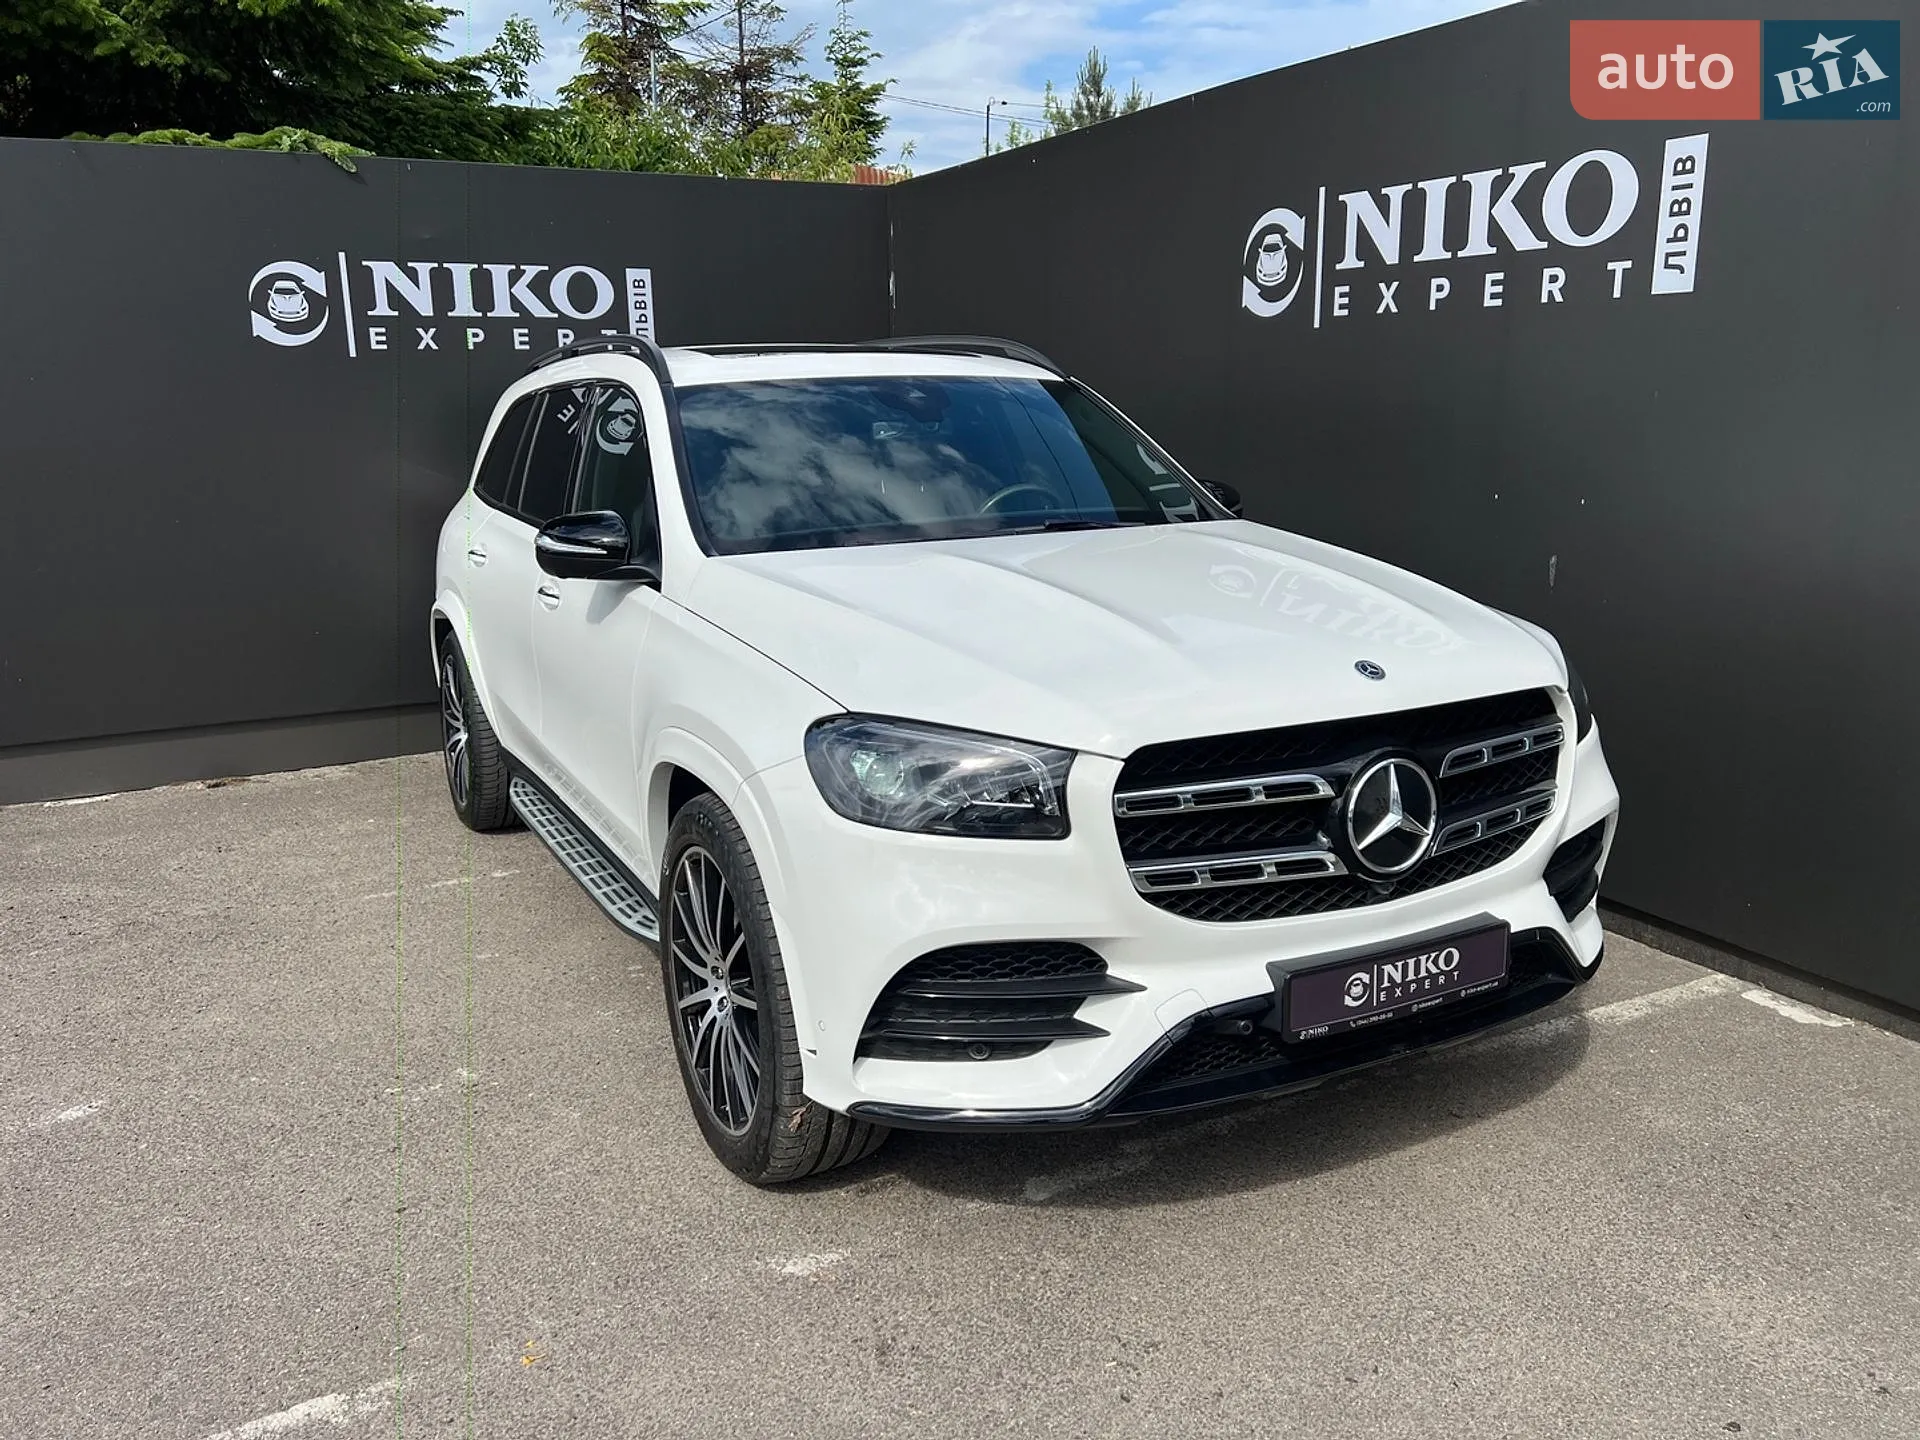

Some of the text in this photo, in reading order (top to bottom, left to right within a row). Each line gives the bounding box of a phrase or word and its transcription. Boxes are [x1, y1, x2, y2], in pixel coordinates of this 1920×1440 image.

[1335, 147, 1639, 271] NIKO
[1662, 153, 1696, 275] ЛЬВІВ
[361, 260, 615, 320] NIKO
[1332, 259, 1632, 317] EXPERT
[1380, 970, 1459, 1002] EXPERT
[1381, 947, 1460, 988] NIKO
[1308, 1025, 1329, 1036] NIKO
